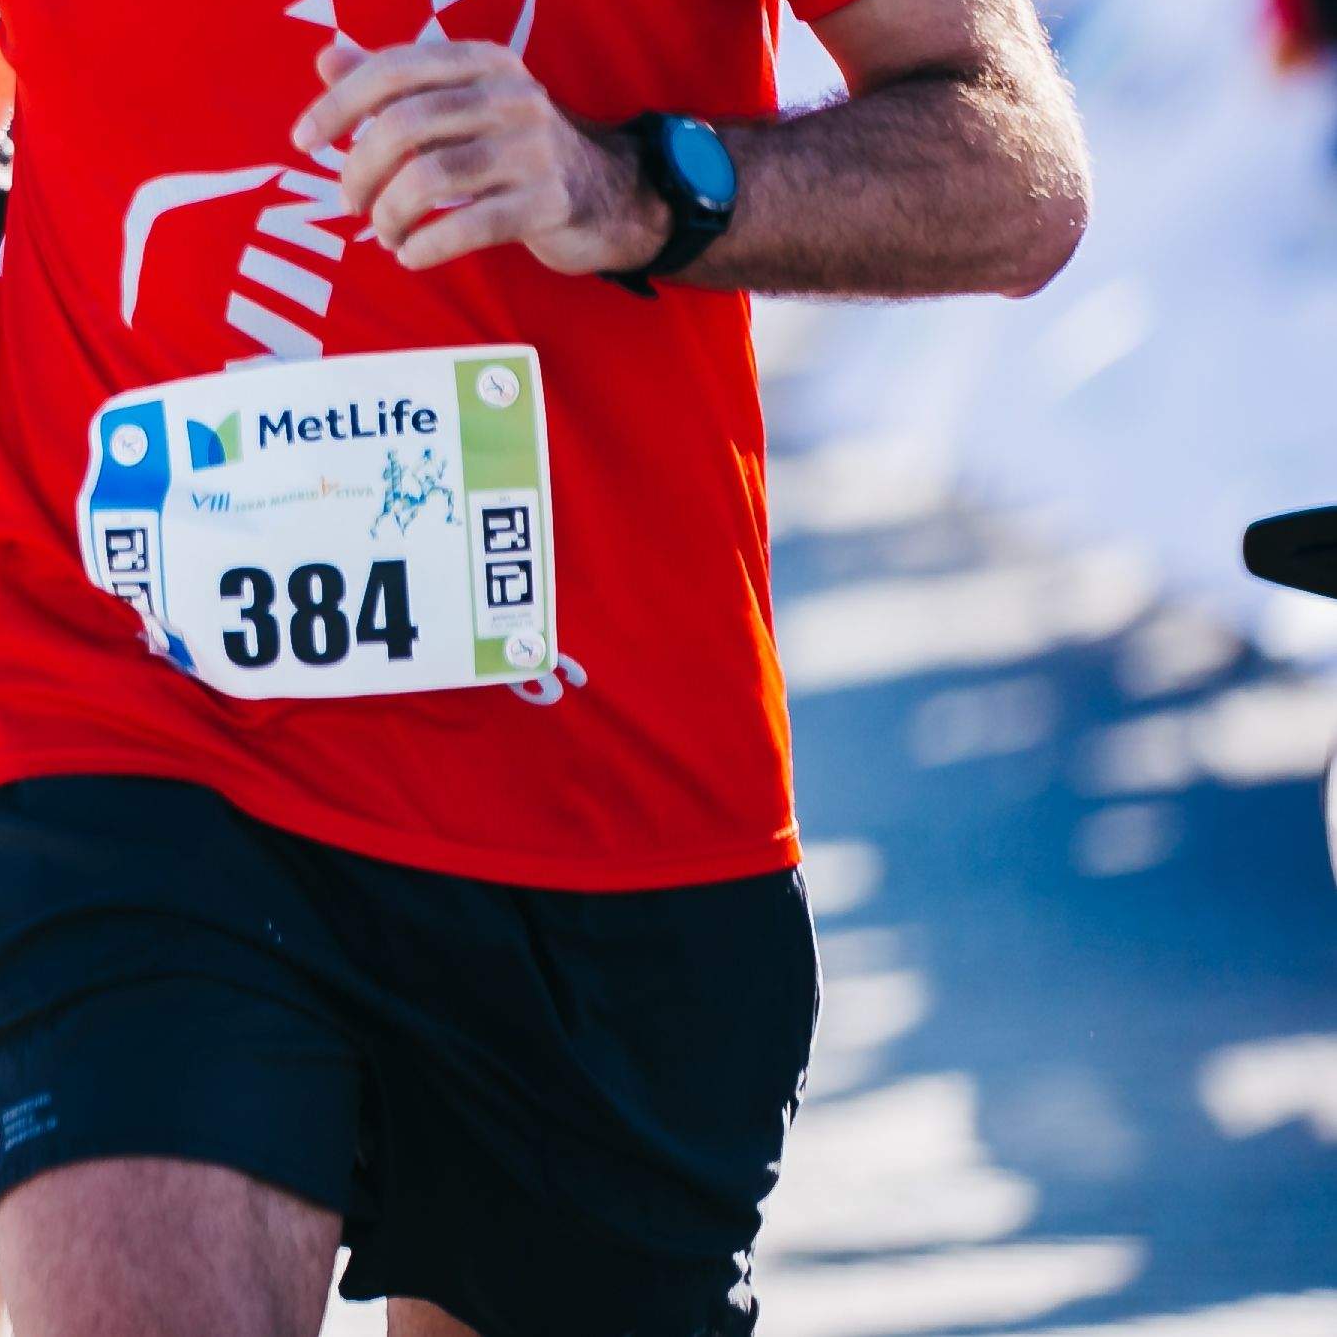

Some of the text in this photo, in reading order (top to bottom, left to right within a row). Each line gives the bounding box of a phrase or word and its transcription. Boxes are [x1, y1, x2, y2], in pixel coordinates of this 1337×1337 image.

[258, 398, 439, 450] MetLife
[191, 492, 231, 512] VIII
[219, 558, 419, 669] 384
